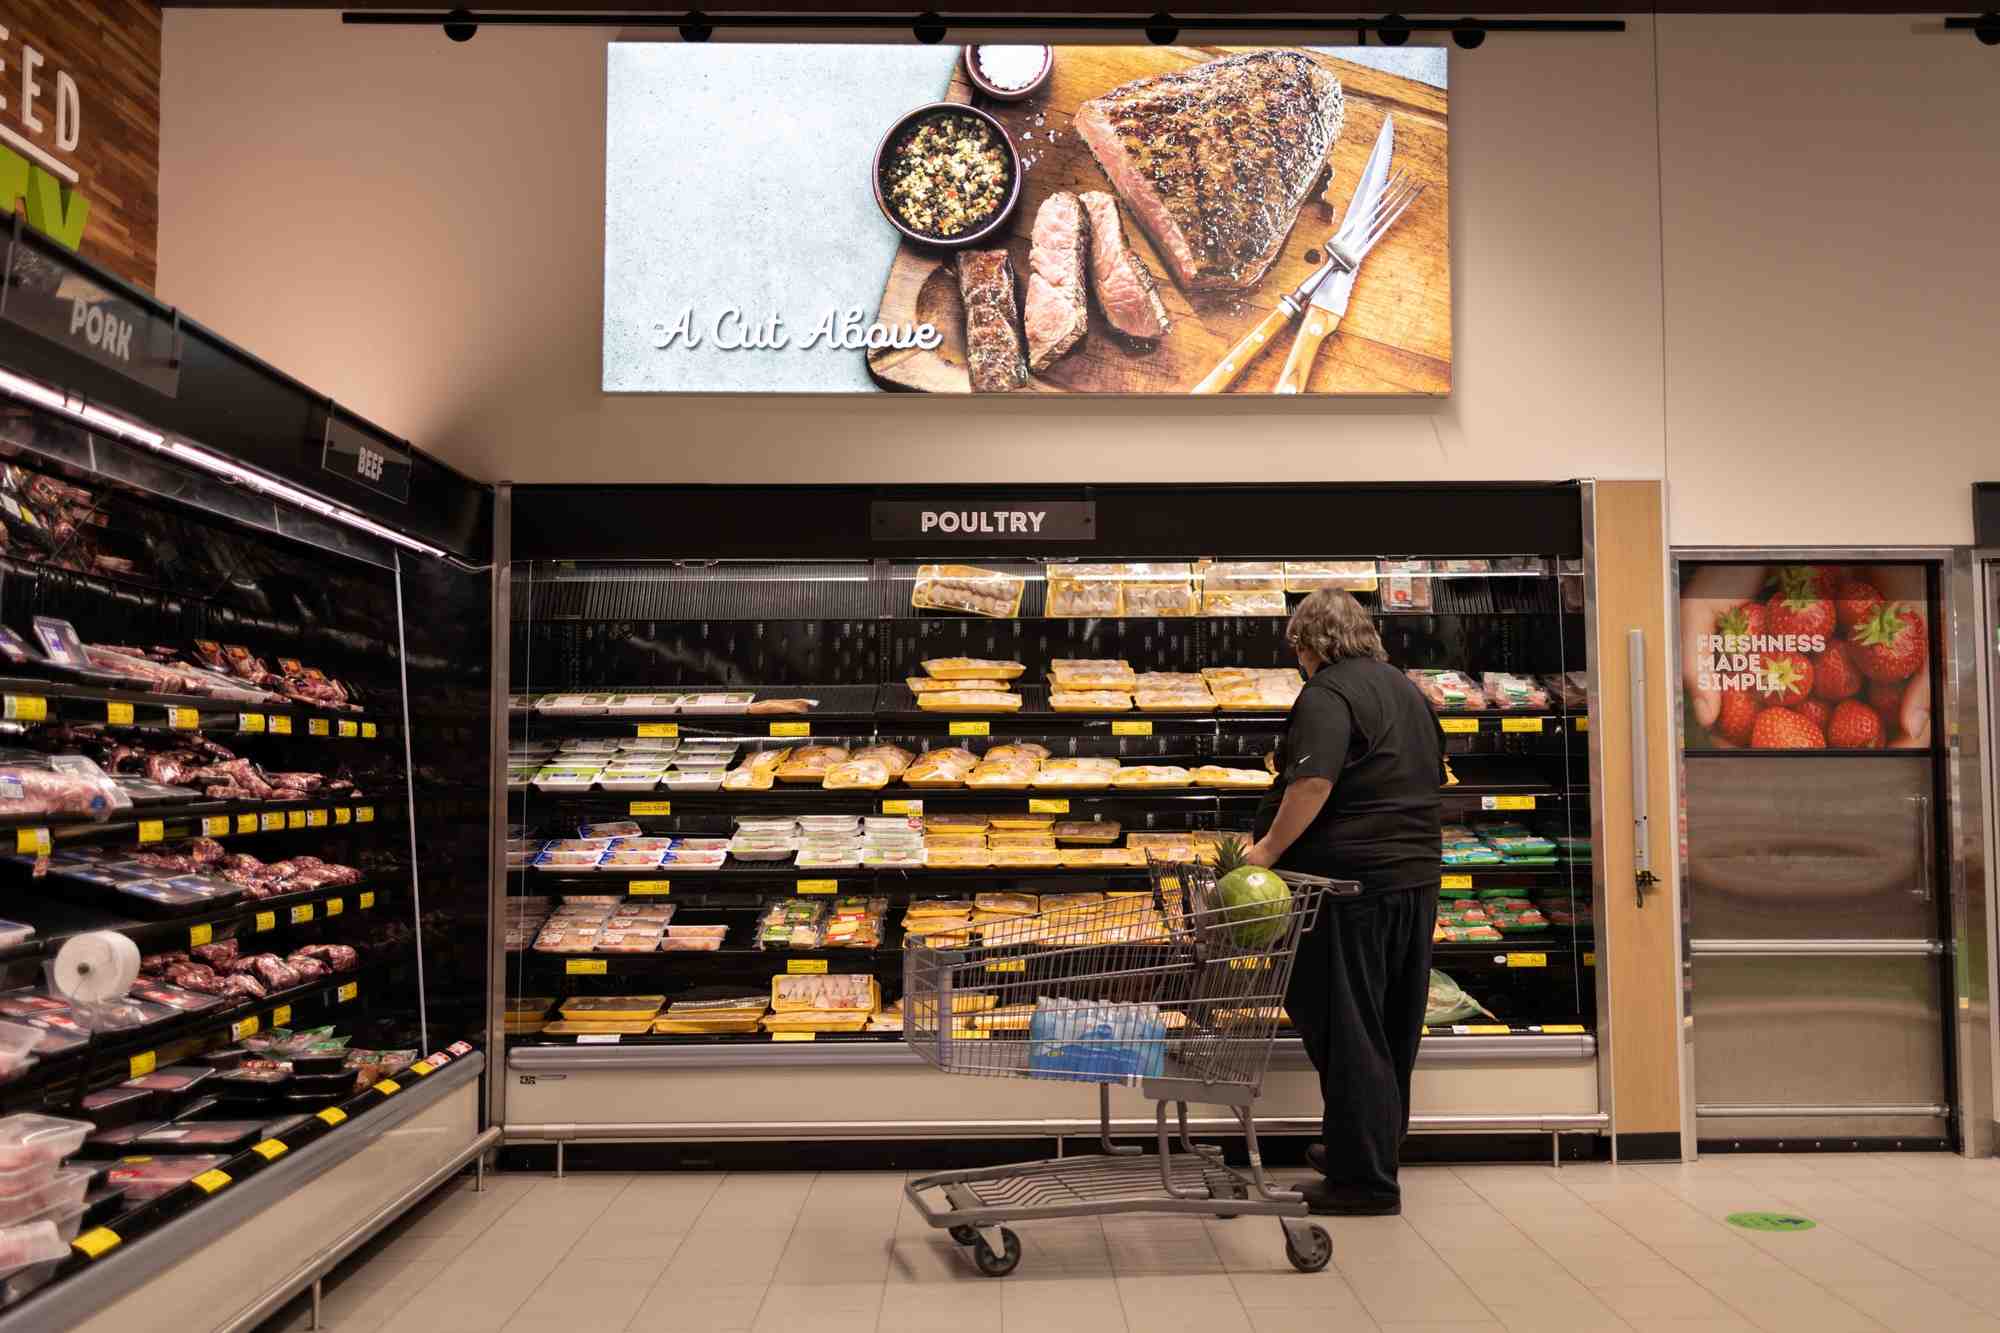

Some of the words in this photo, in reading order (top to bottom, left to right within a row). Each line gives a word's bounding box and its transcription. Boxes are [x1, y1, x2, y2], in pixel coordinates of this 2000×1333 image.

[71, 297, 133, 361] PORK
[651, 304, 701, 349] A
[712, 304, 789, 349] Cut
[799, 304, 944, 349] Above
[358, 447, 384, 481] BEEF
[920, 511, 1046, 533] POULTRY
[1696, 634, 1826, 652] FRESHNESS
[1696, 654, 1760, 672] MADE
